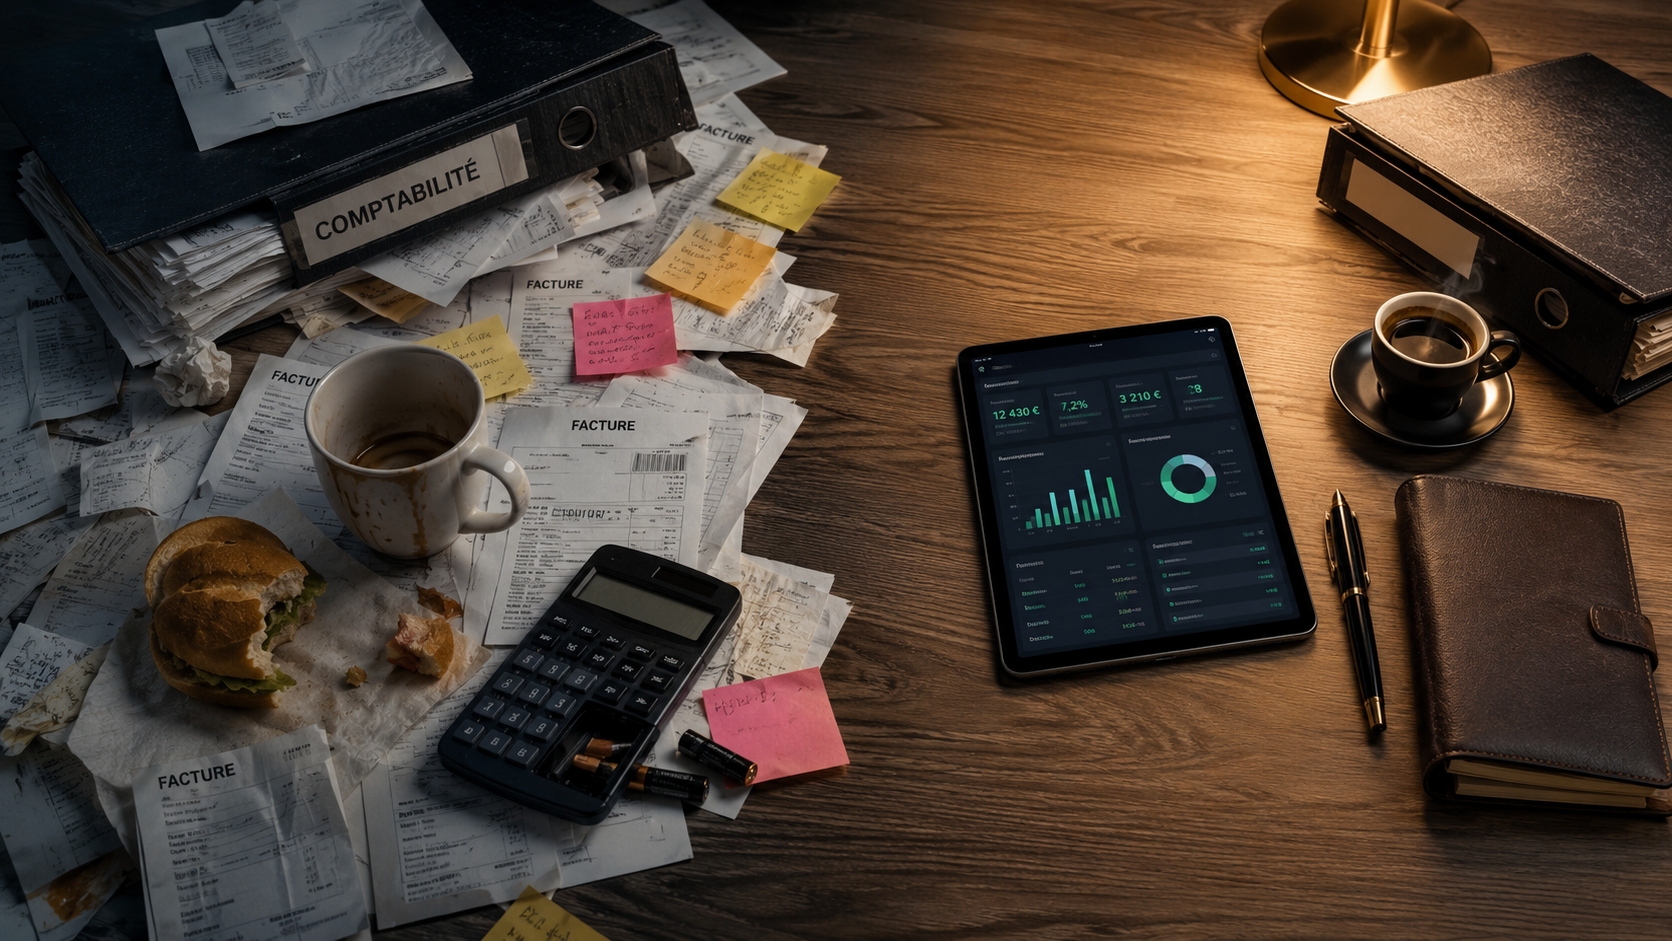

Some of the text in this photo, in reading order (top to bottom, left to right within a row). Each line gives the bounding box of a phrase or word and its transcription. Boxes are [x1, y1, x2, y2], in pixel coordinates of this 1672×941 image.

[314, 157, 481, 241] COMPTABILITÉ
[526, 279, 584, 290] FACTURE
[271, 369, 321, 387] FACTU
[1119, 394, 1127, 404] 3
[1129, 391, 1151, 403] 210
[992, 409, 1007, 420] 12
[1008, 406, 1030, 418] 430
[571, 419, 636, 431] FACTURE
[157, 763, 236, 789] FACTURE
